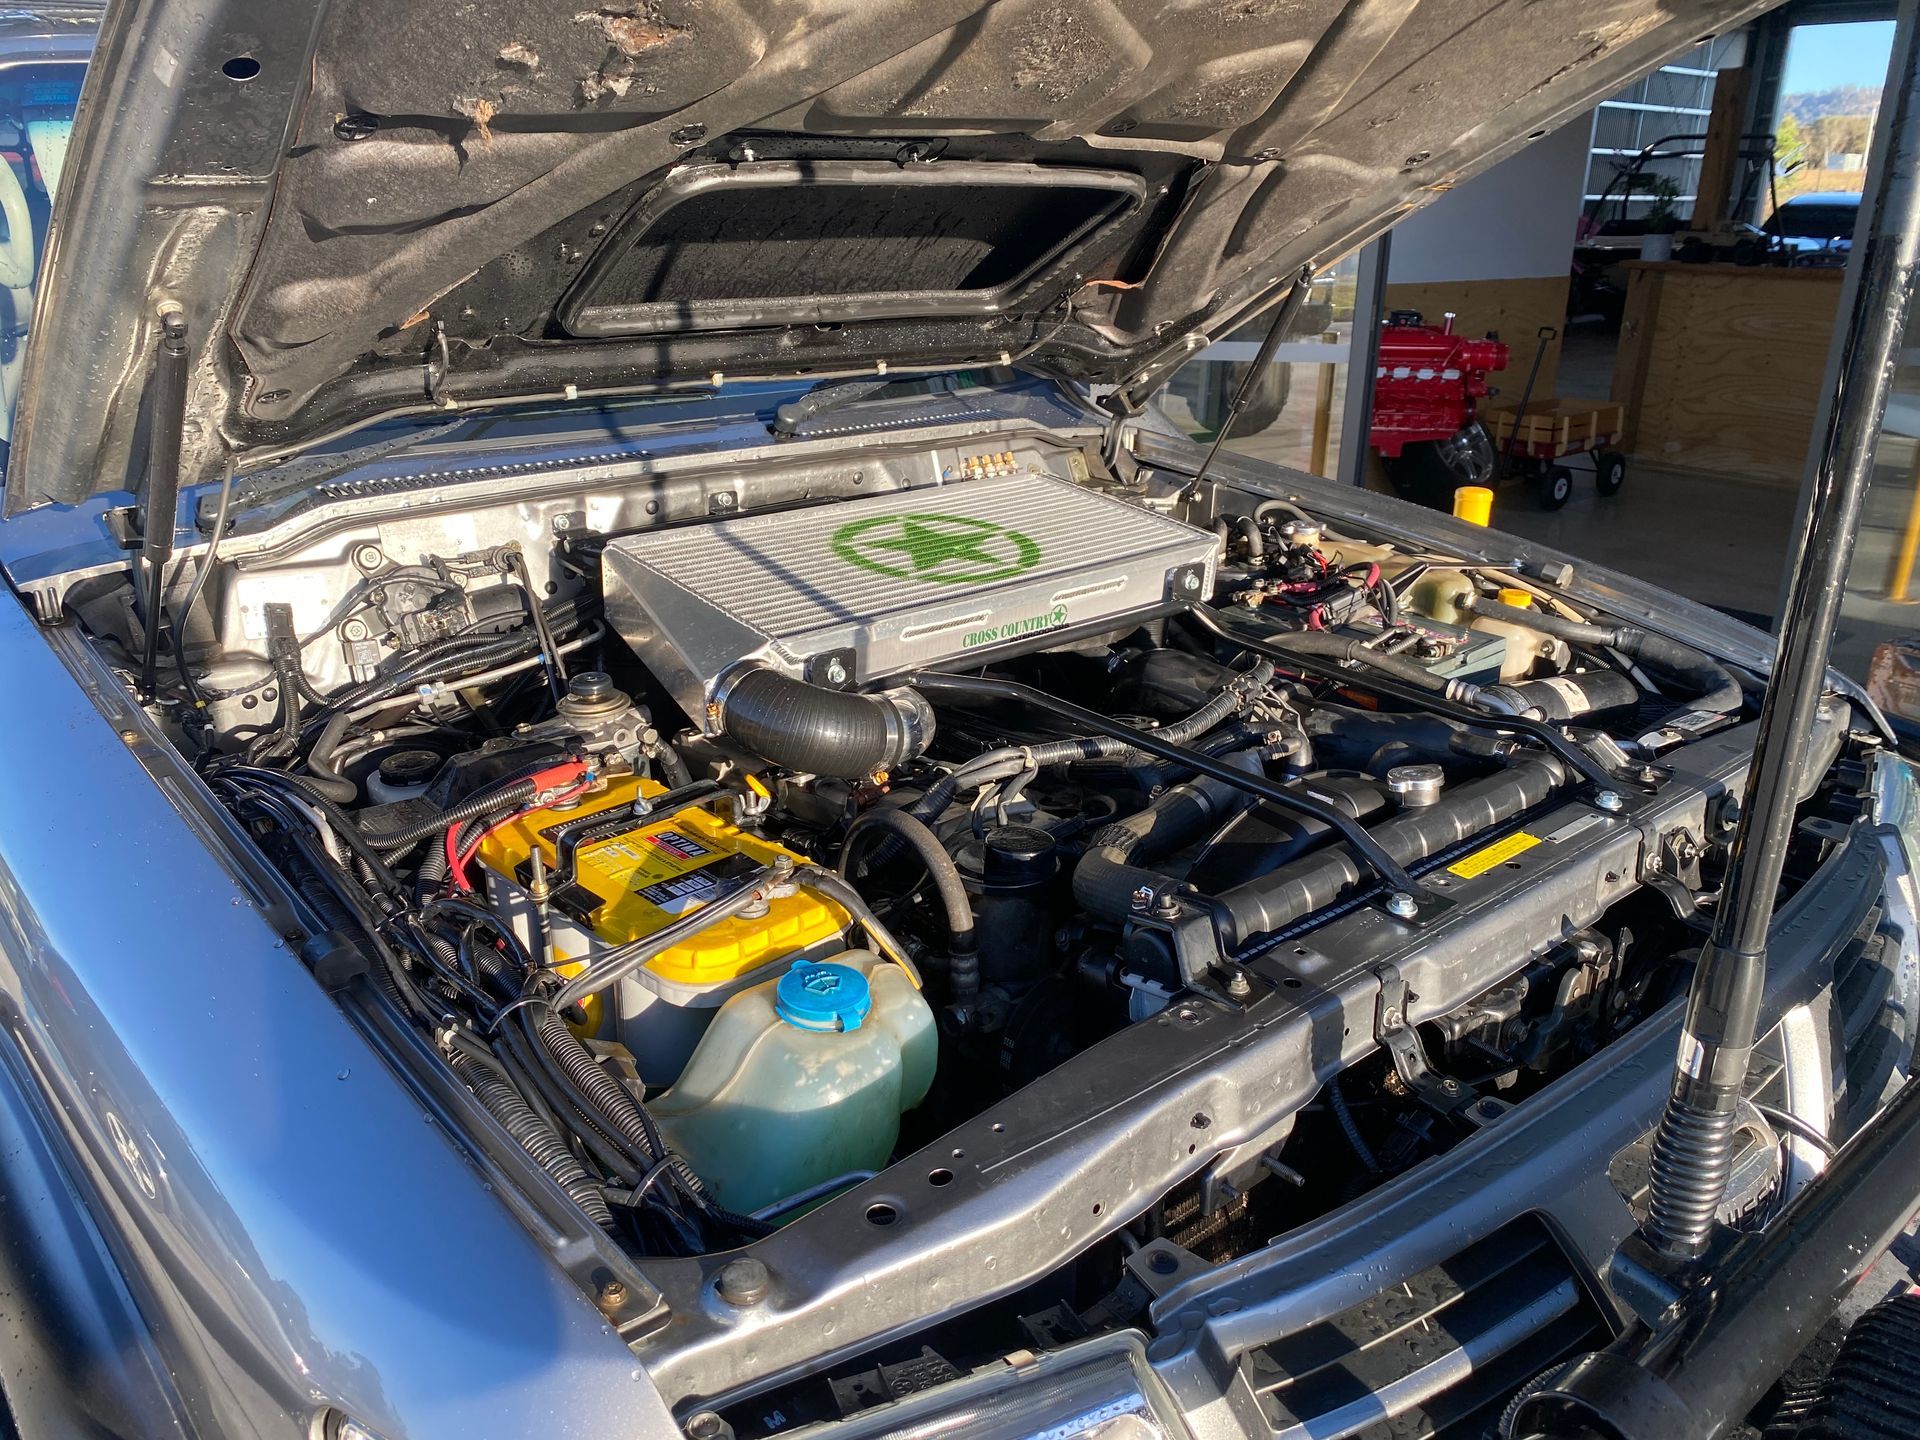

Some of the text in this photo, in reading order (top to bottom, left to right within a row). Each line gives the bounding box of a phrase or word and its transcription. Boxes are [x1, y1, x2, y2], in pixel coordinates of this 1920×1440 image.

[962, 613, 1053, 647] CROSS COUNTRY
[657, 832, 707, 856] OPTIMA
